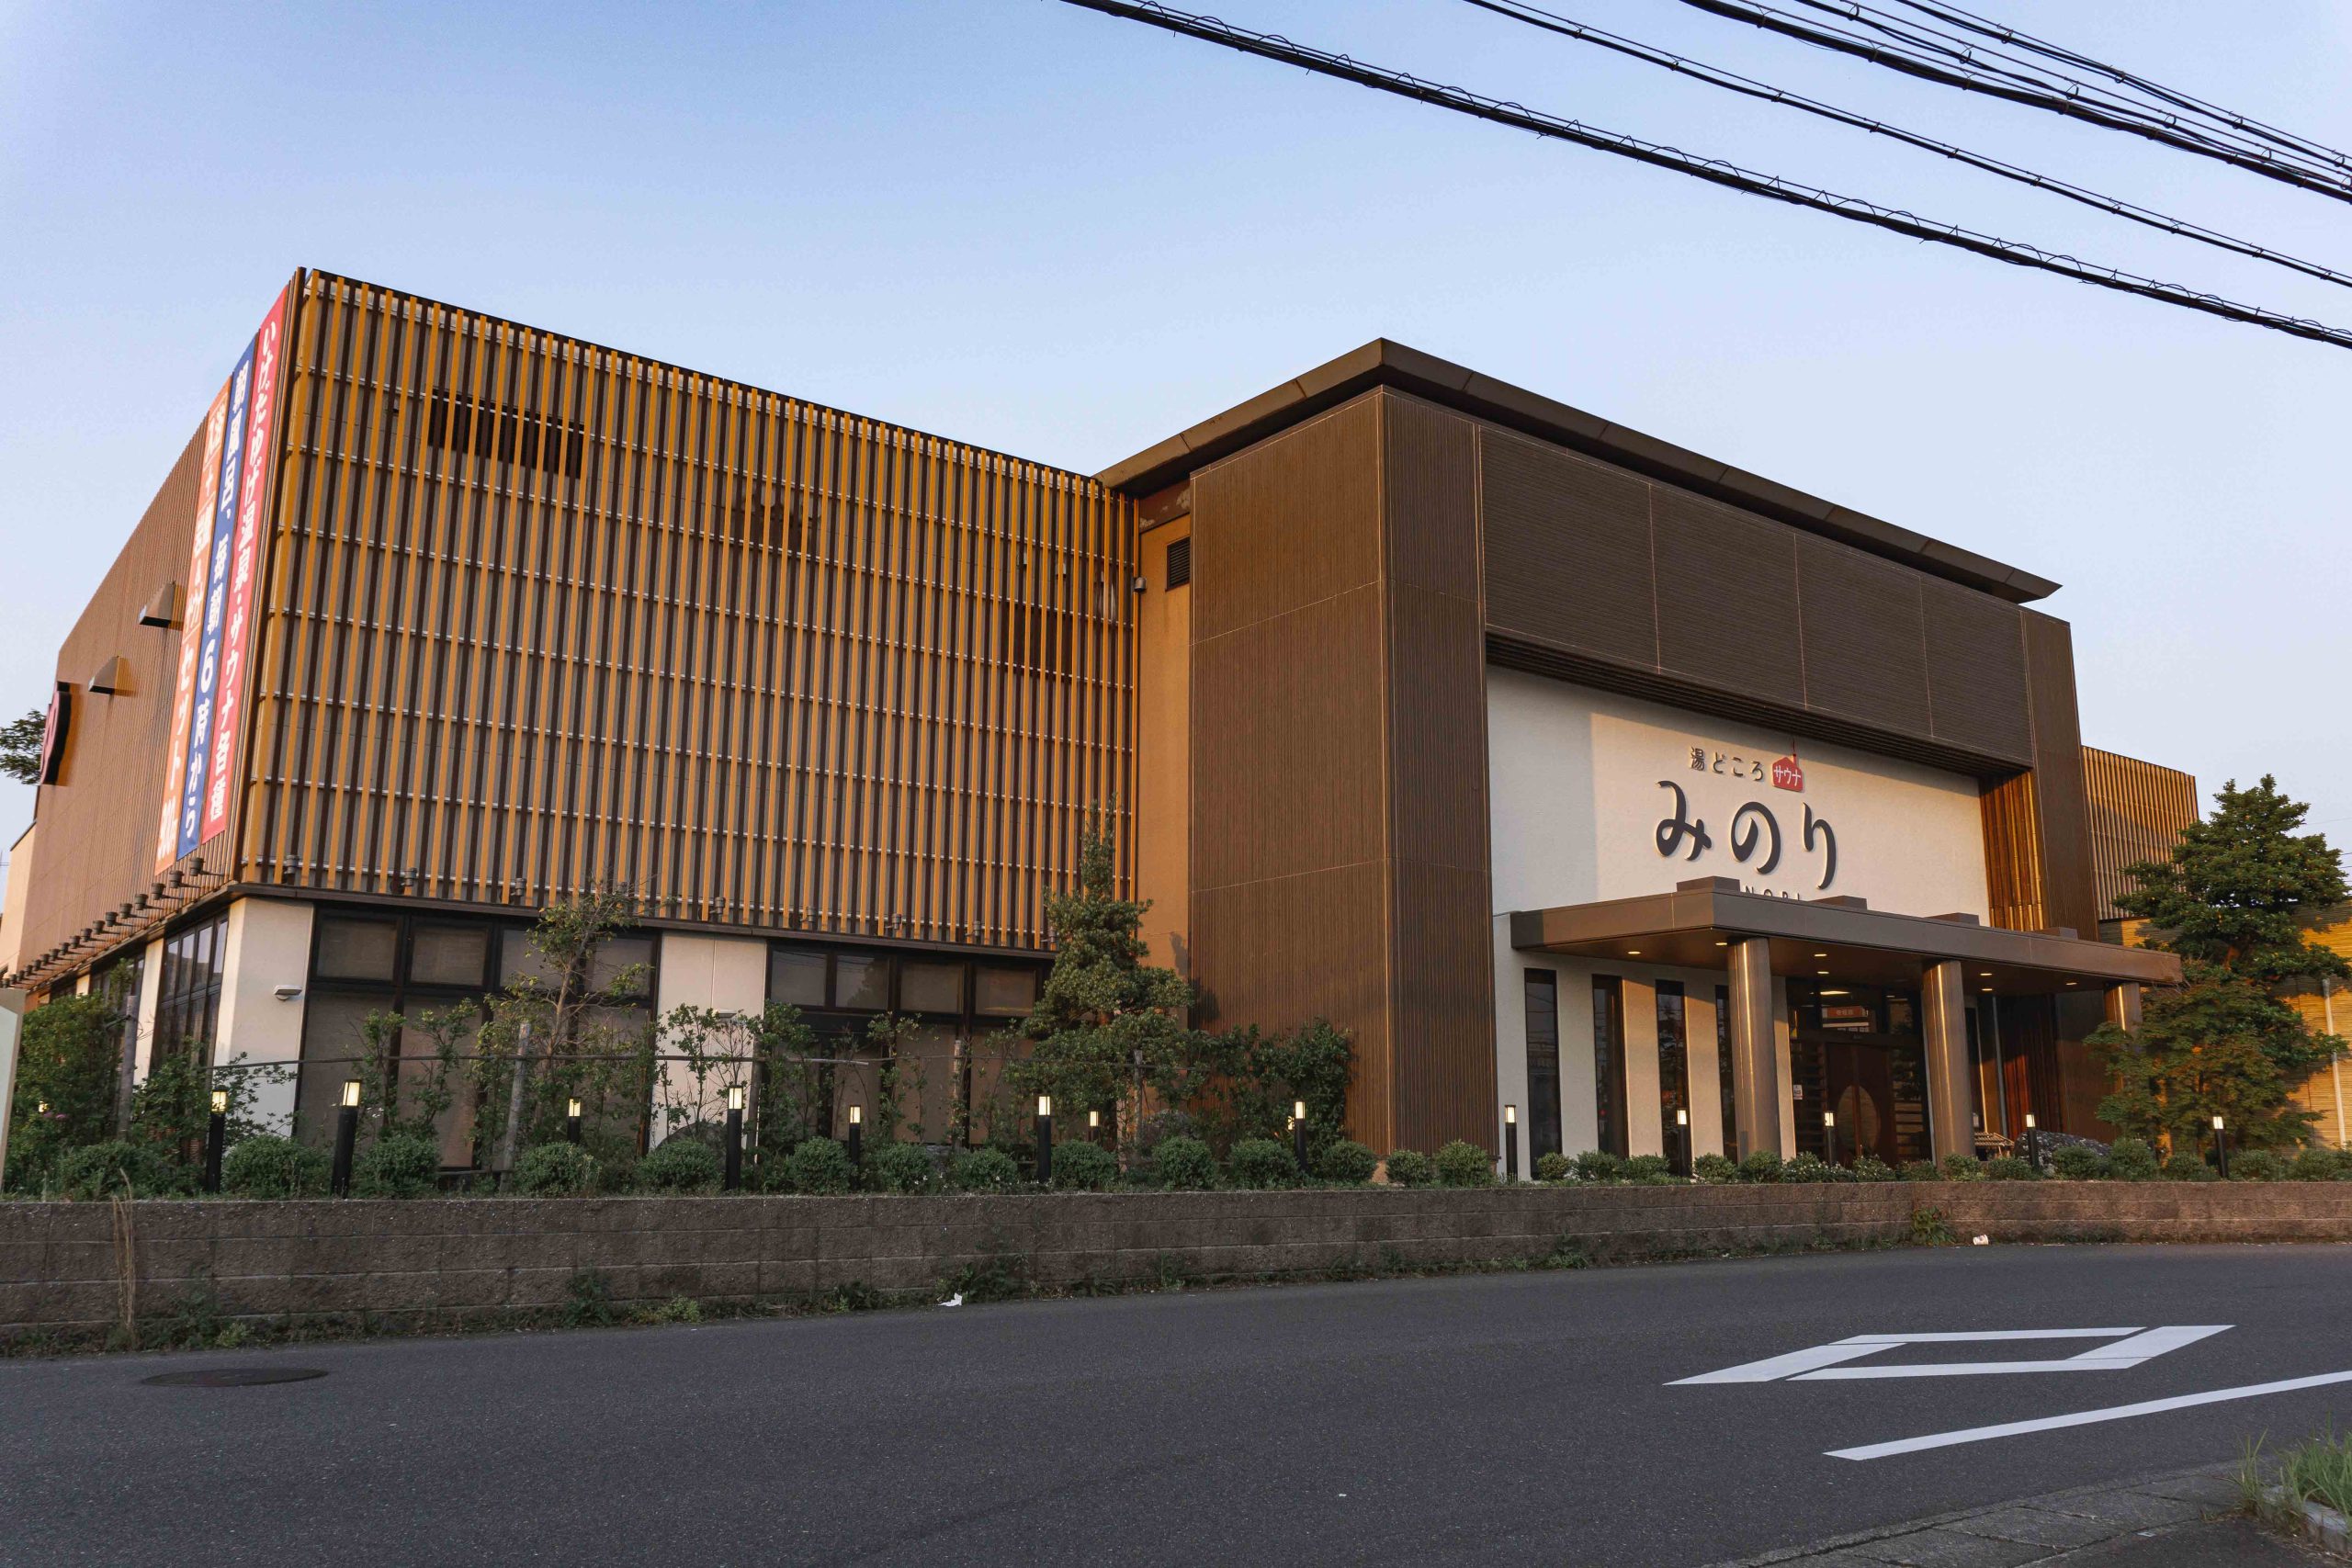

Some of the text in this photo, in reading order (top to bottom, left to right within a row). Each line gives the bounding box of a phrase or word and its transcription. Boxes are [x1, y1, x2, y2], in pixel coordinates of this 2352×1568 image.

[186, 359, 250, 838] 朝風呂、毎朝6時から
[1690, 746, 1764, 782] 湯どころ
[1773, 764, 1802, 787] サウナ
[1656, 780, 1838, 890] みのり
